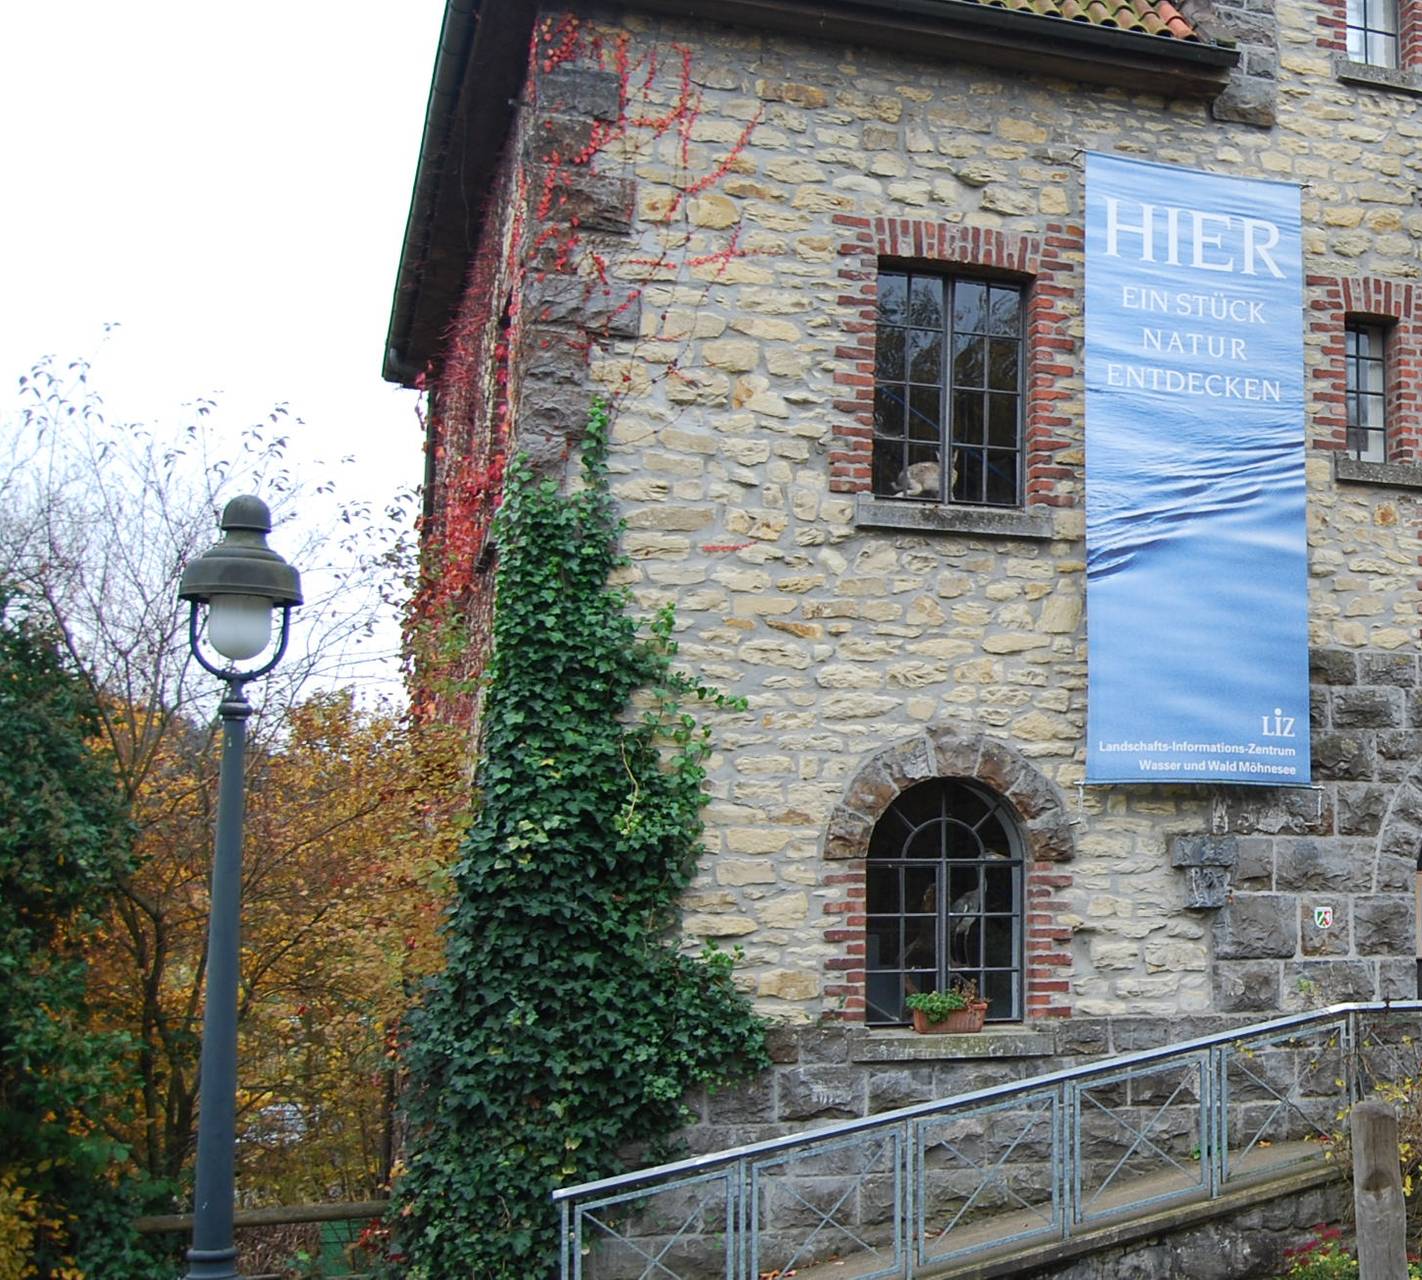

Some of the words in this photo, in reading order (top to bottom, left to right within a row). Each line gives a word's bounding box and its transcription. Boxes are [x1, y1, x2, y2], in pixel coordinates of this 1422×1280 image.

[1102, 196, 1287, 280] HIER
[1122, 286, 1169, 313] EIN
[1176, 292, 1267, 324] STÜCK
[1142, 327, 1248, 361] NATUR
[1106, 363, 1281, 402] ENTDECKEN
[1099, 741, 1296, 757] Landschafts-Informations-Zentrum
[1138, 759, 1181, 772] Wasser
[1183, 760, 1206, 772] und
[1208, 761, 1237, 773] Wald
[1239, 761, 1296, 776] Möhnesee
